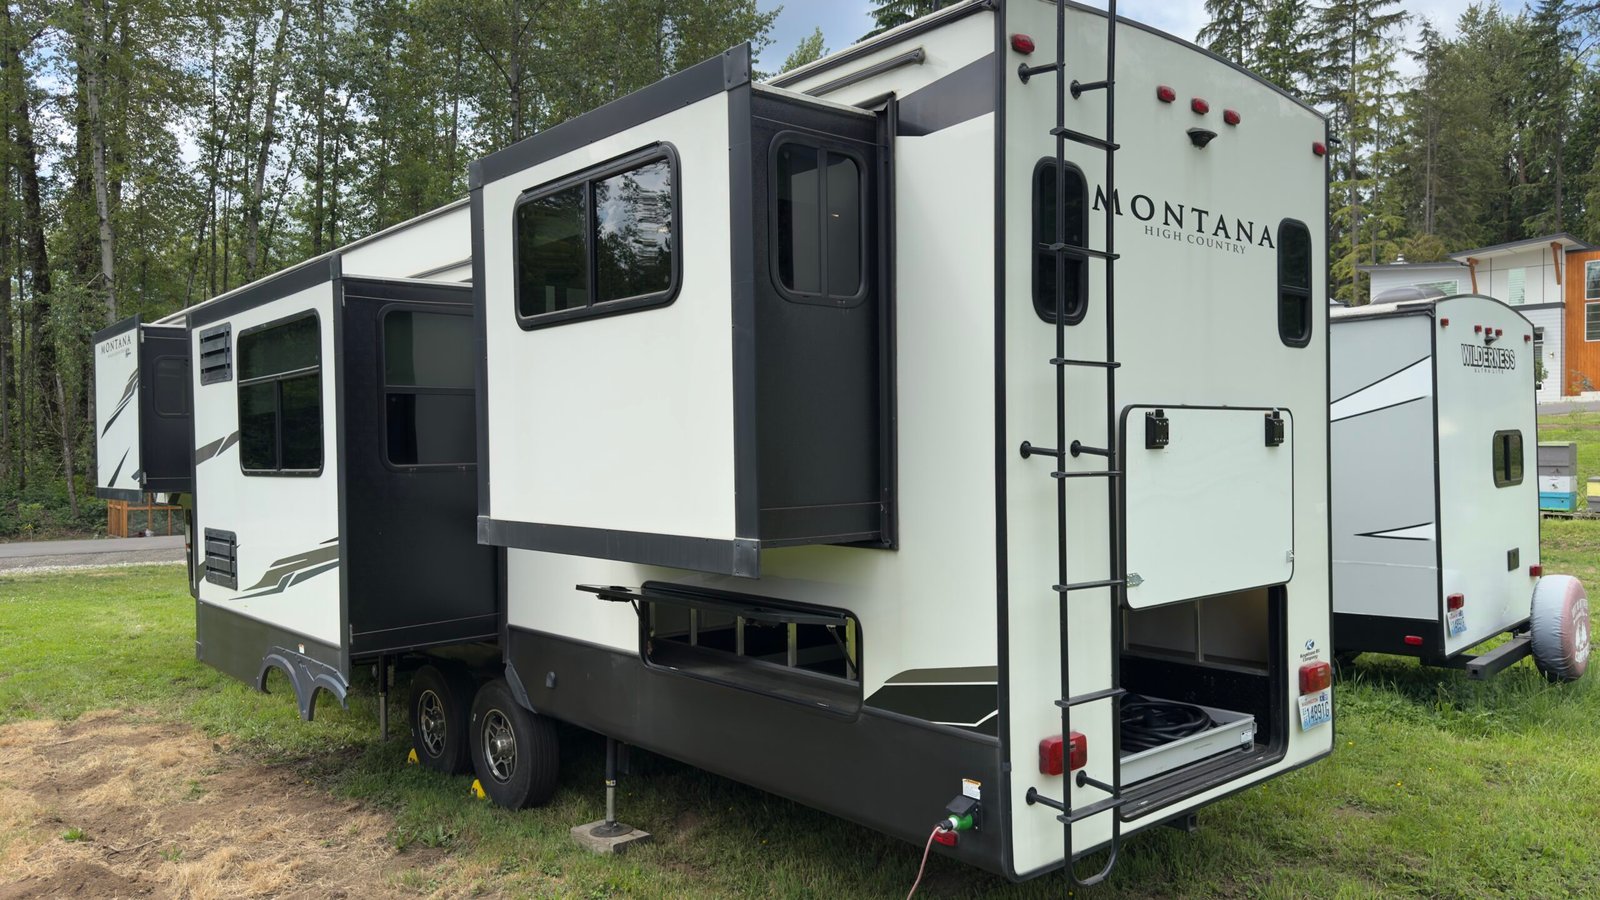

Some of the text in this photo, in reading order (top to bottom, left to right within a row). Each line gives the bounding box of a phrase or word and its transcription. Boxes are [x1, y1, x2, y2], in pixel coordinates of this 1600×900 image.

[1092, 184, 1275, 249] MONTANA
[1144, 225, 1246, 254] HIGH COUNTRY
[101, 334, 132, 354] MONTANA
[1461, 343, 1516, 370] WILDERNESS
